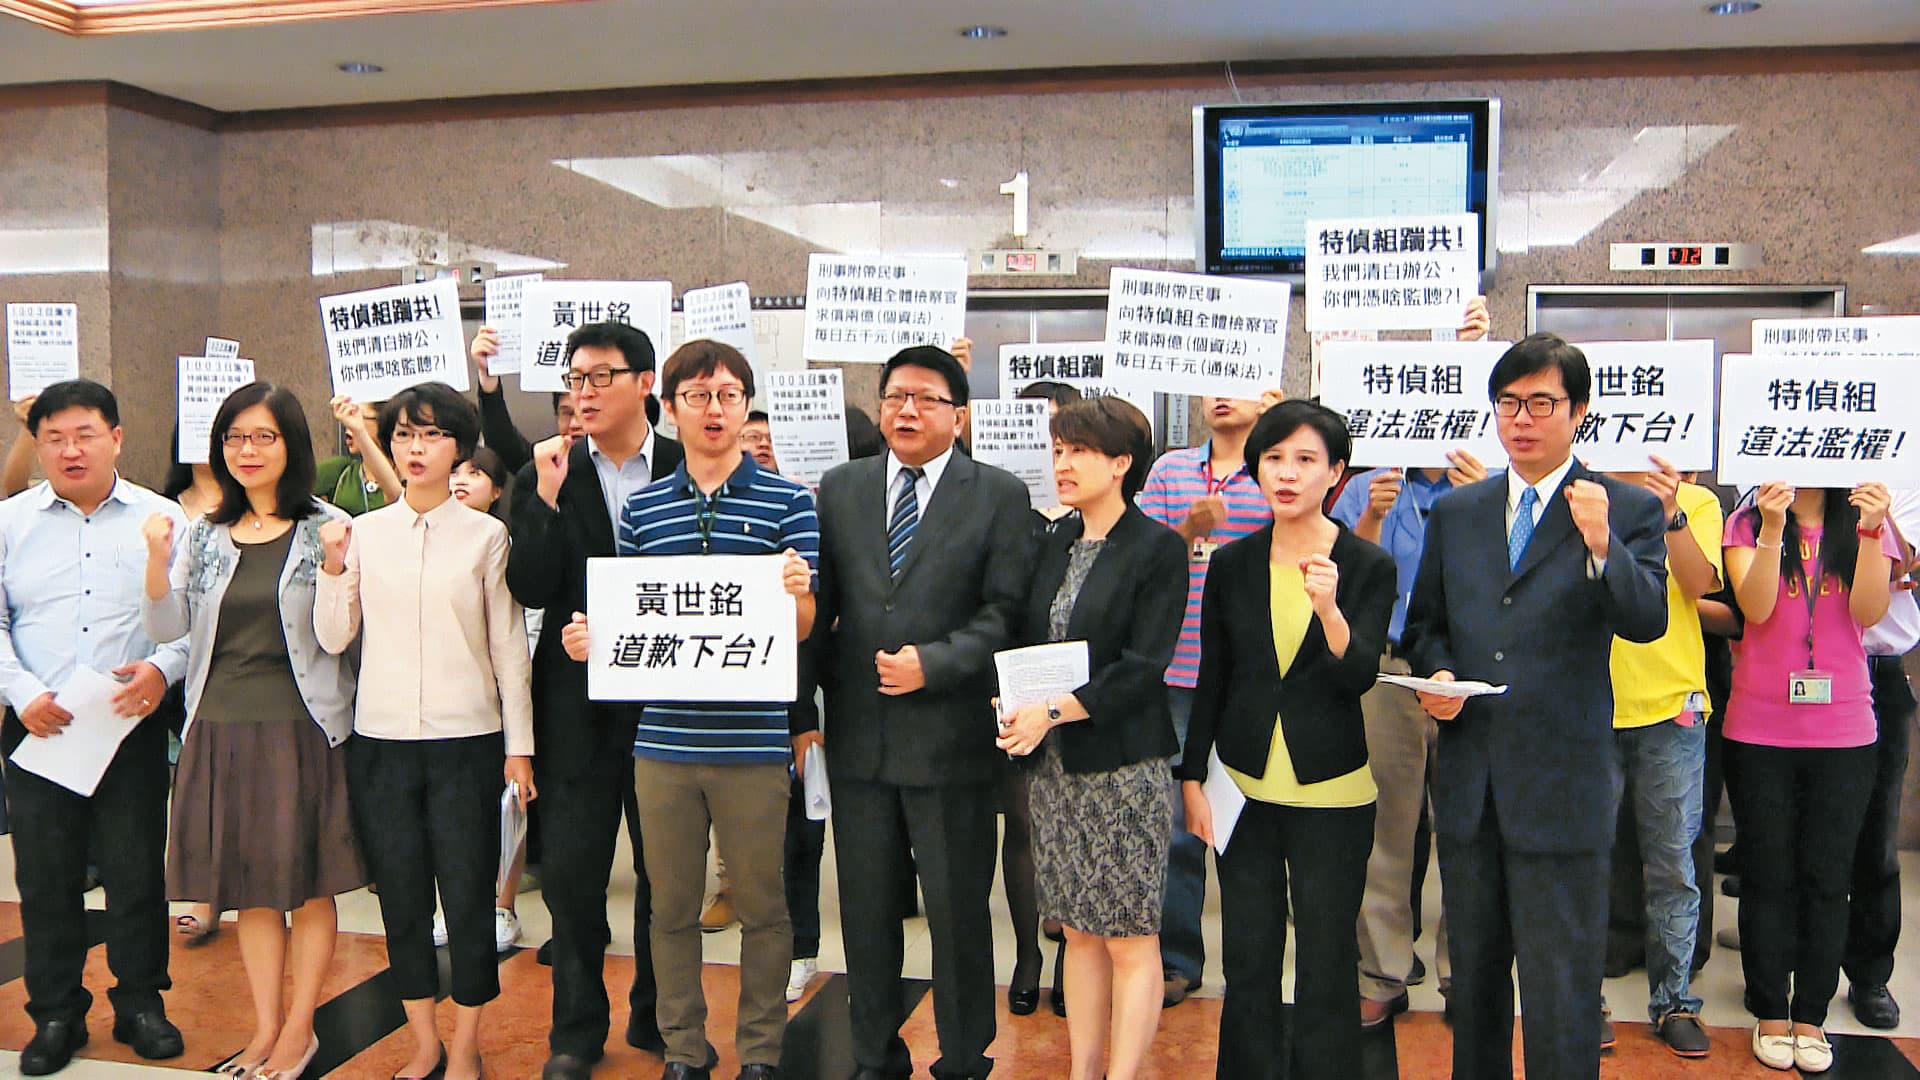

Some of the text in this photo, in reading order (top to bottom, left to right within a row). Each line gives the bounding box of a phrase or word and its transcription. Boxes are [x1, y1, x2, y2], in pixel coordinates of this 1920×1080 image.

[1000, 170, 1028, 236] 1
[1319, 225, 1463, 254] 特偵組踹共!
[817, 285, 958, 304] 向特偵組全體檢察官
[329, 294, 441, 331] 特偵組踹共!
[553, 301, 631, 328] 黃世銘
[1119, 305, 1278, 334] 向特偵組全體檢察官
[1363, 364, 1463, 395] 特偵組
[1768, 379, 1876, 412] 特偵組
[1737, 425, 1906, 460] 違法濫權!
[636, 582, 743, 616] 黃世銘
[608, 633, 774, 668] 道歉下台!
